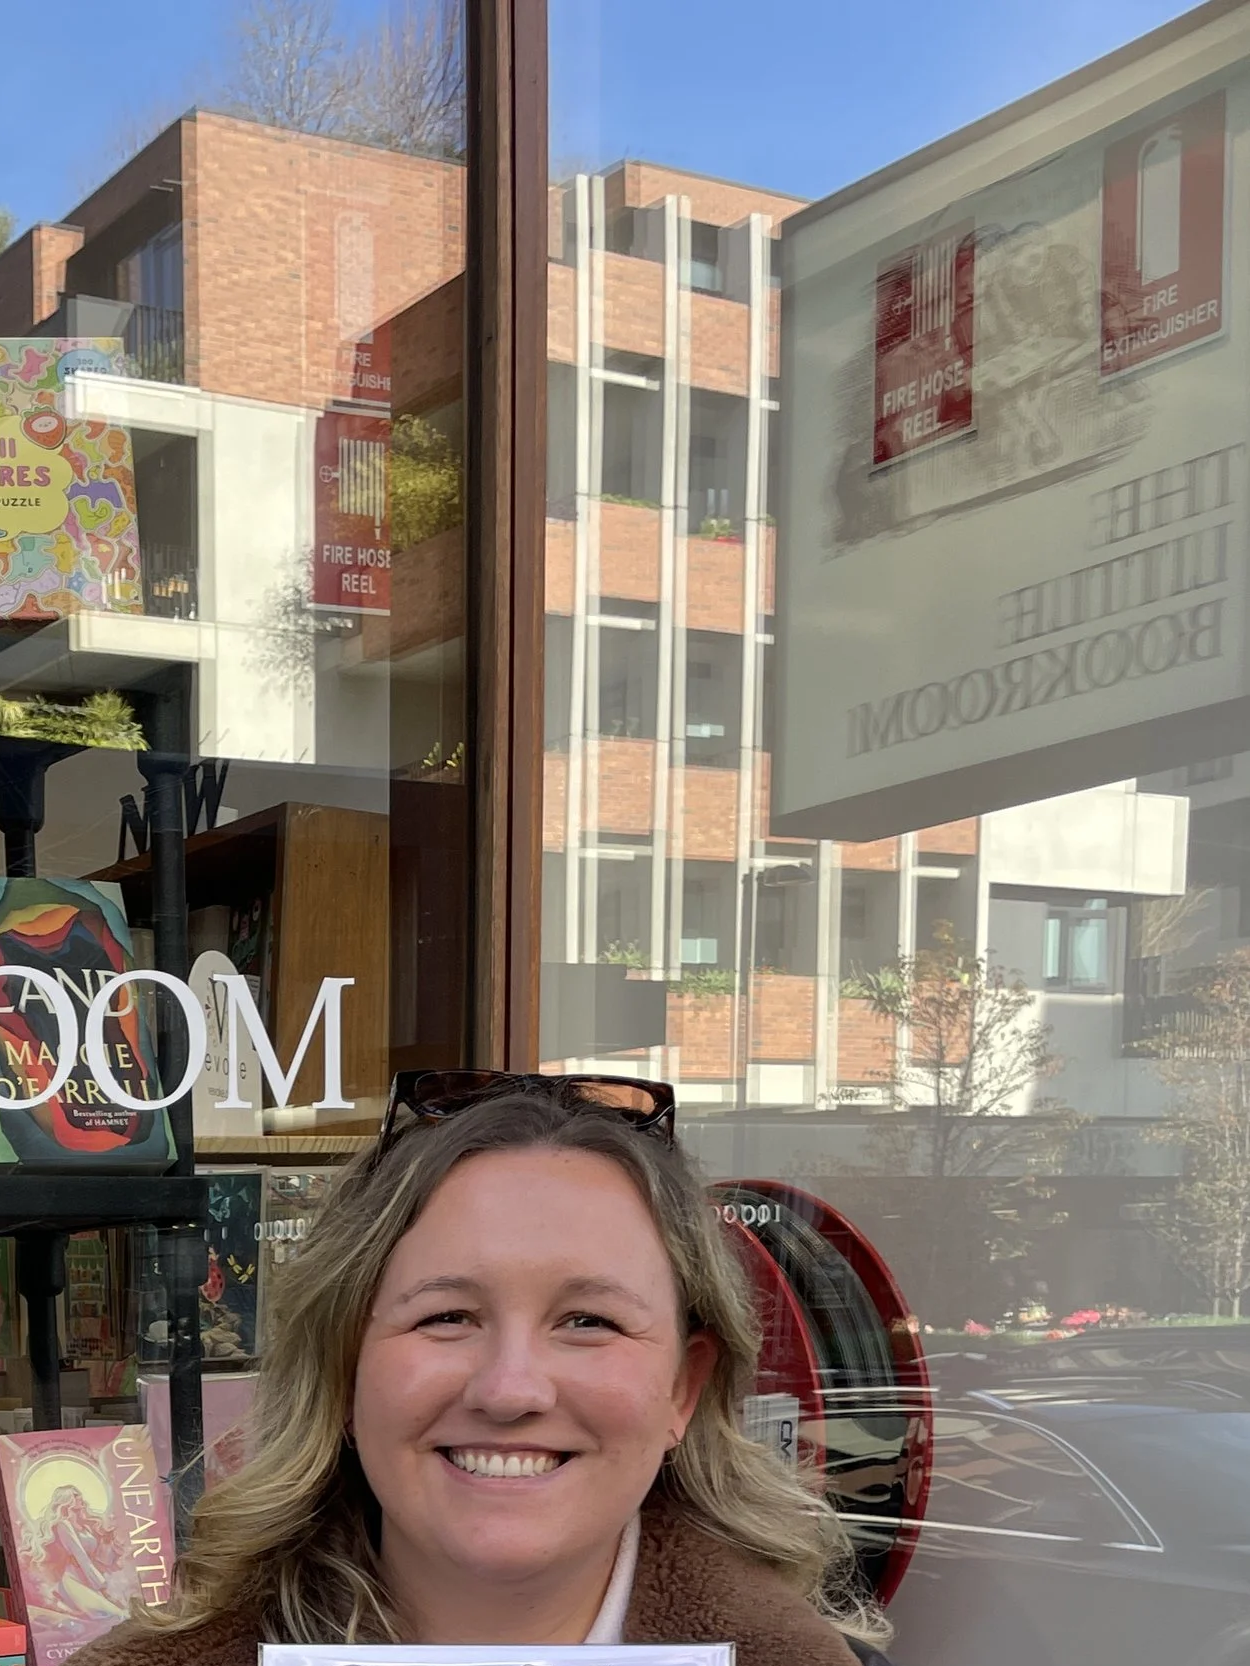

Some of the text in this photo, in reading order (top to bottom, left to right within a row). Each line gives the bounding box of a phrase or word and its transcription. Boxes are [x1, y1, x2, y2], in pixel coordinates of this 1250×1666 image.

[1101, 300, 1219, 362] EXTINGUISHER
[881, 359, 965, 418] FIRE HOSE
[901, 406, 942, 444] REEL
[322, 544, 391, 569] FIRE HOSE
[341, 573, 376, 594] REEL
[112, 1437, 168, 1607] UNEARTH
